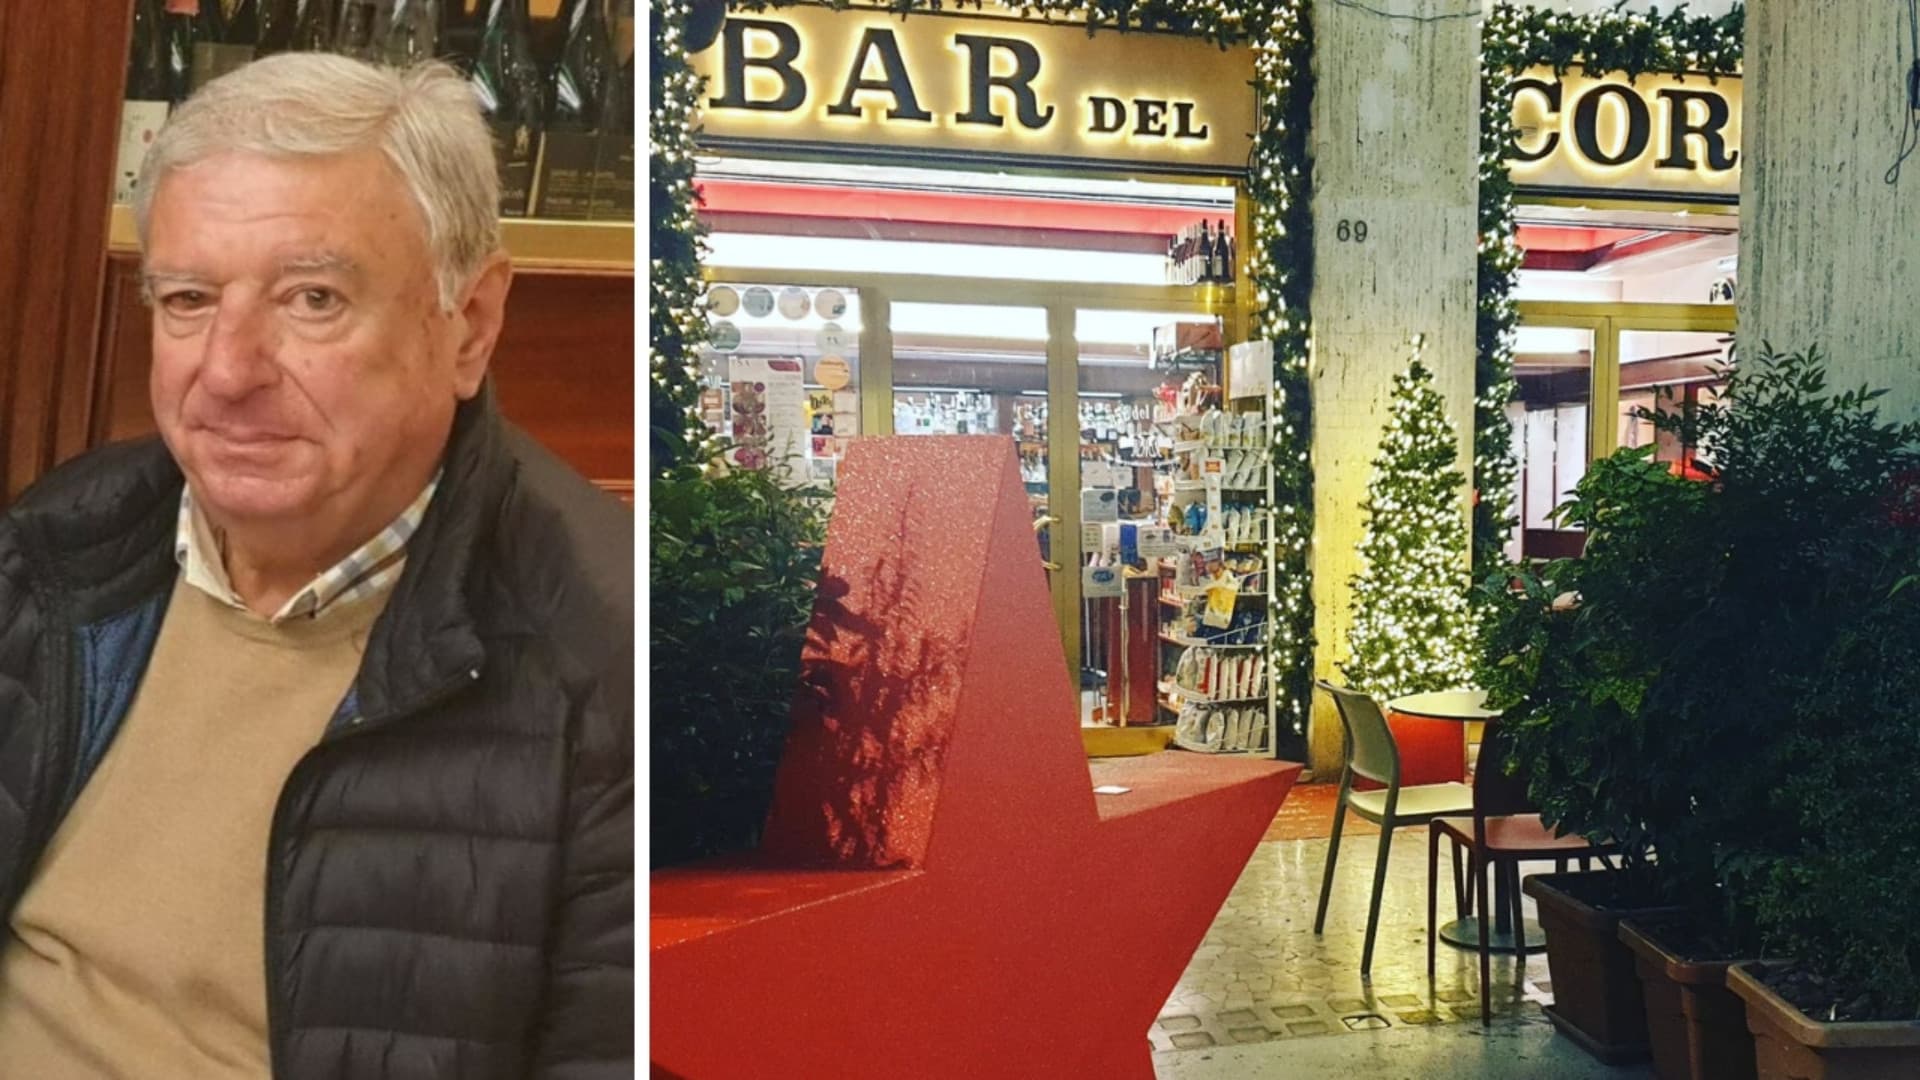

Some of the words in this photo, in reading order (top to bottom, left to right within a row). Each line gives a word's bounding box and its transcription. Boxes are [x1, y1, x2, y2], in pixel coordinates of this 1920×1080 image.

[709, 18, 1054, 129] BAR
[1088, 96, 1208, 139] DEL
[1337, 219, 1368, 243] 69
